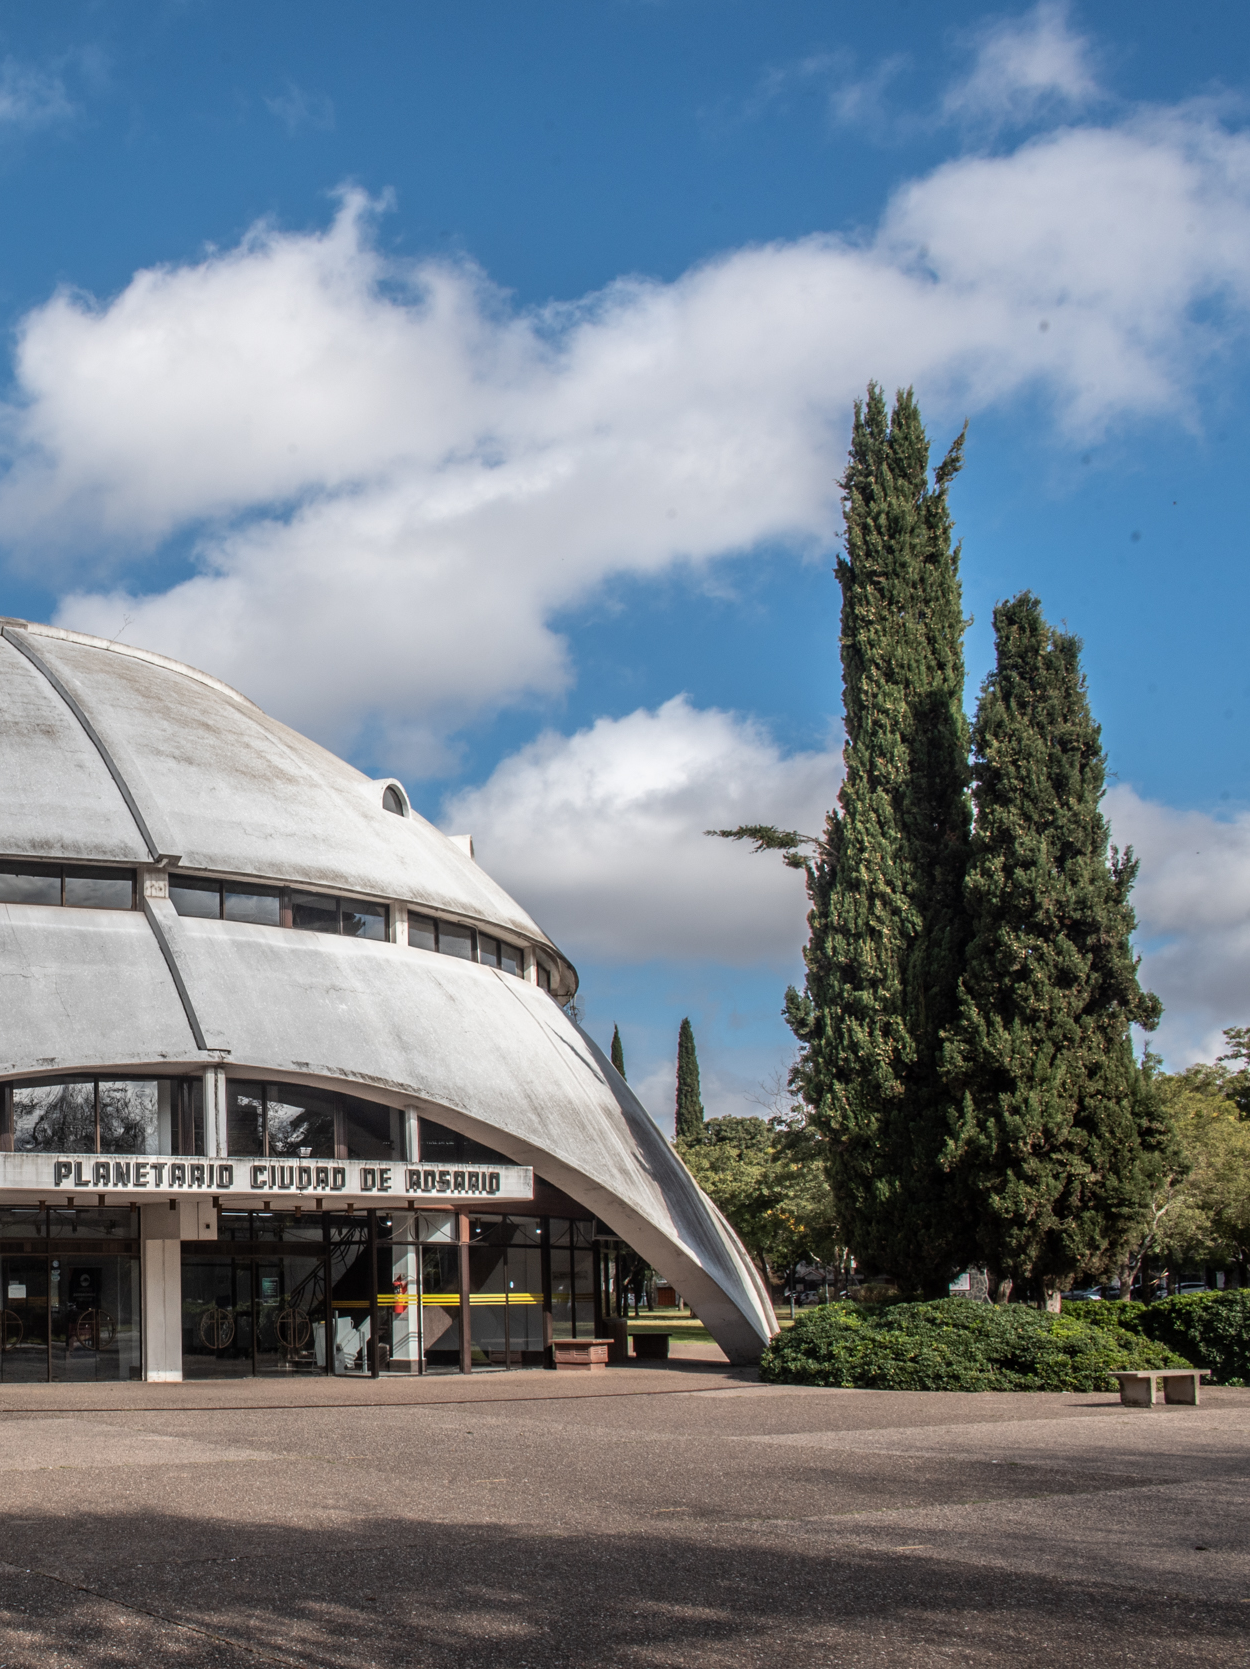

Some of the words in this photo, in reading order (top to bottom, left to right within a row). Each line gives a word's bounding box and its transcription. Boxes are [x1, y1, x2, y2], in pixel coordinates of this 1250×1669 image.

[54, 1161, 233, 1188] PLANETARIO
[250, 1165, 345, 1190] CIUDAD
[360, 1167, 391, 1191] DE
[405, 1169, 500, 1194] ROSARIO
